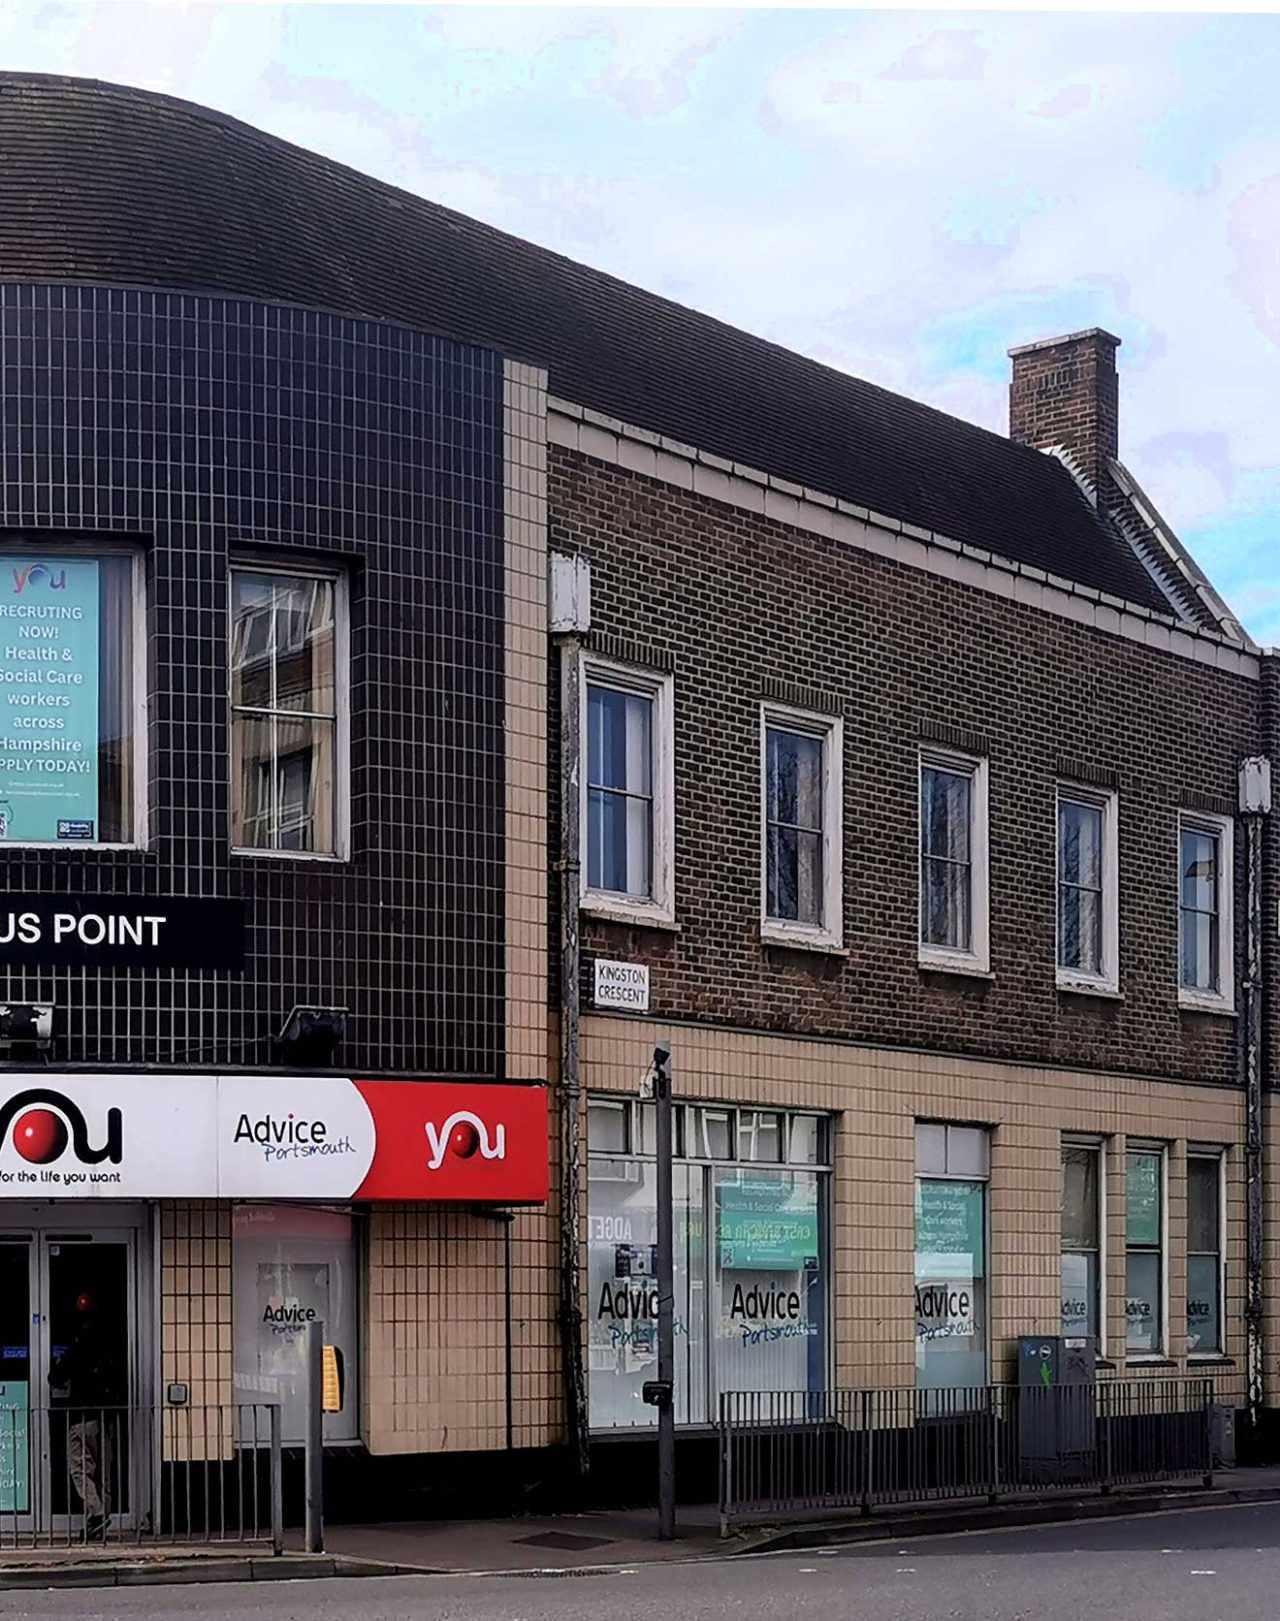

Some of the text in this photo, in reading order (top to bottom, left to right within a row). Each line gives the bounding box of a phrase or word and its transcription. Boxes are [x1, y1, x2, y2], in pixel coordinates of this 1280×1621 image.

[12, 562, 66, 594] you
[19, 625, 59, 638] NOW!
[4, 646, 73, 661] Health &
[46, 669, 83, 684] Care
[7, 691, 70, 706] workers
[12, 716, 65, 729] across
[36, 759, 91, 773] TODAY!
[53, 914, 167, 946] POINT
[598, 964, 646, 985] KINGSTON
[598, 984, 646, 1004] CRESCENT
[233, 1113, 327, 1144] Advice
[261, 1136, 356, 1162] Portsmouth
[425, 1111, 505, 1170] you
[17, 1170, 38, 1182] the
[40, 1170, 61, 1182] life
[63, 1173, 87, 1186] you
[89, 1171, 121, 1182] want
[598, 1281, 660, 1320] Advic
[730, 1282, 801, 1320] Advice
[263, 1304, 316, 1322] Advice
[739, 1316, 817, 1348] Portsmouth
